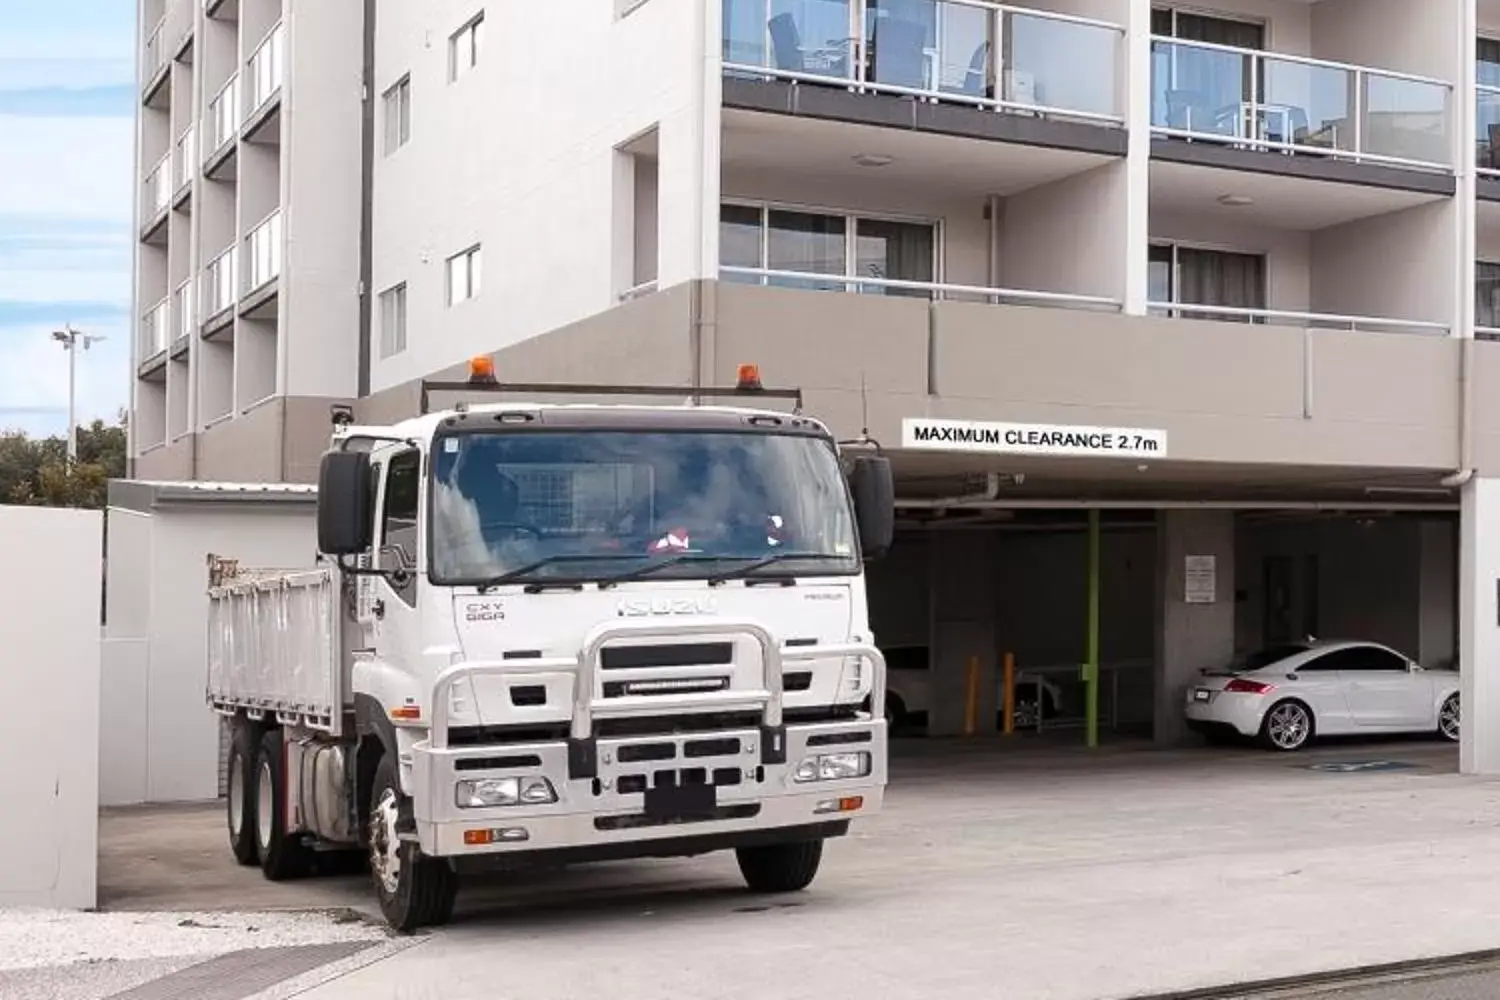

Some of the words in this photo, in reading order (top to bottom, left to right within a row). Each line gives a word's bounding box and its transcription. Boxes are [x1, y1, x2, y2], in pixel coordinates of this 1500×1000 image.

[914, 426, 999, 444] MAXIMUM
[1005, 430, 1112, 449] CLEARANCE
[1118, 435, 1158, 450] 2.7m
